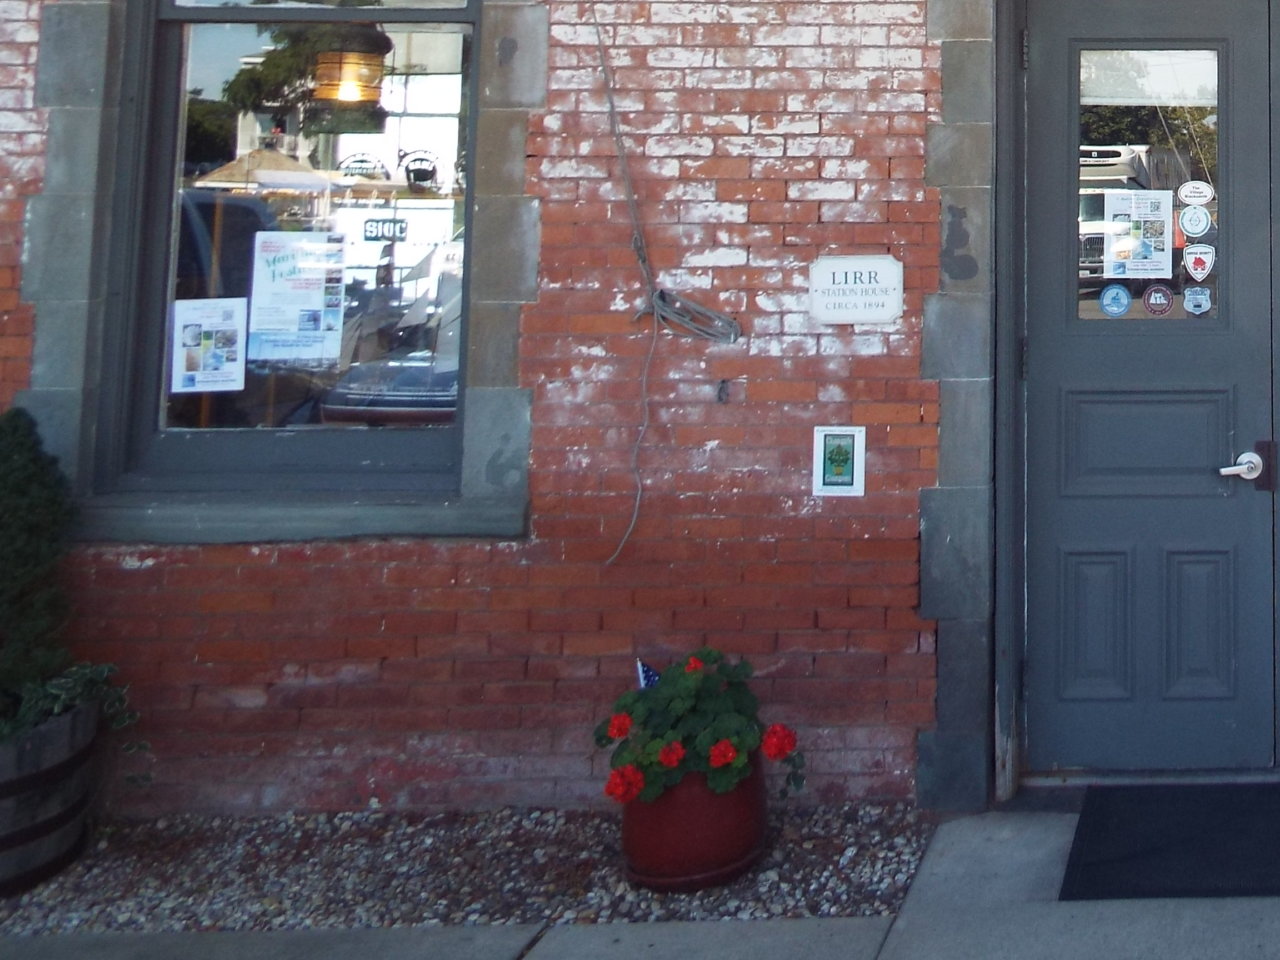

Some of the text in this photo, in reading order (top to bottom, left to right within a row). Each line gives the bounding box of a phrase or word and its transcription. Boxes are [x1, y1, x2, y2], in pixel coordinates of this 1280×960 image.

[831, 271, 881, 286] LIRR
[820, 287, 891, 298] STATION HOUSE
[825, 301, 886, 311] CIRCA 1894
